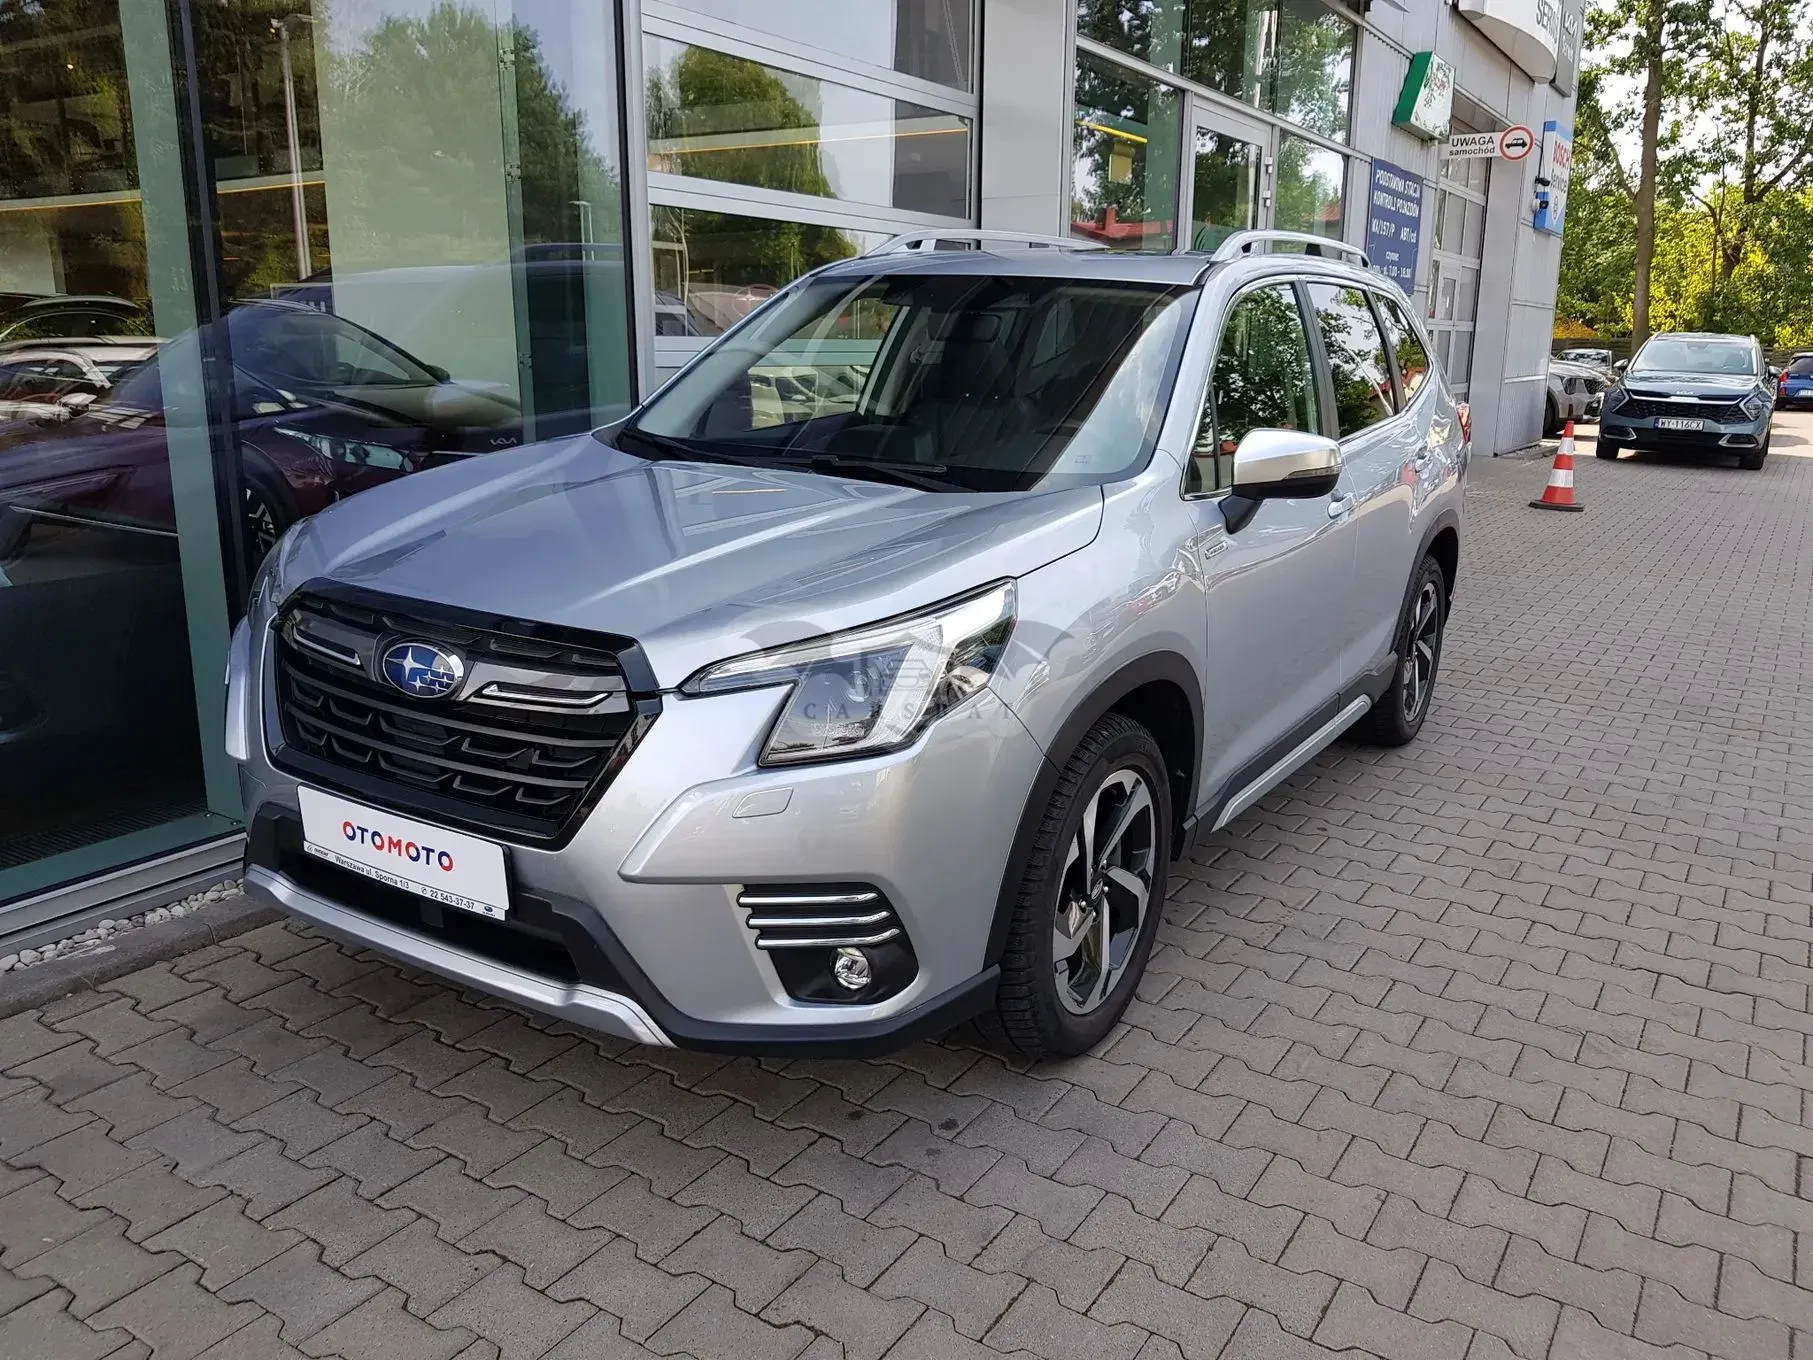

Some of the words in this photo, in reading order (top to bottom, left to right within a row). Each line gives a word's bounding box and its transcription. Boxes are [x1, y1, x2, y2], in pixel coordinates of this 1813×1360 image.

[1449, 146, 1496, 156] samochód
[1451, 136, 1495, 147] UWAGA
[342, 821, 454, 872] OTOMOTO
[335, 855, 364, 873] Warszawa
[366, 867, 374, 876] ul.
[375, 871, 398, 885] Sporna
[400, 880, 409, 889] 1/3
[430, 890, 439, 899] 22
[440, 893, 475, 909] 543-37-37
